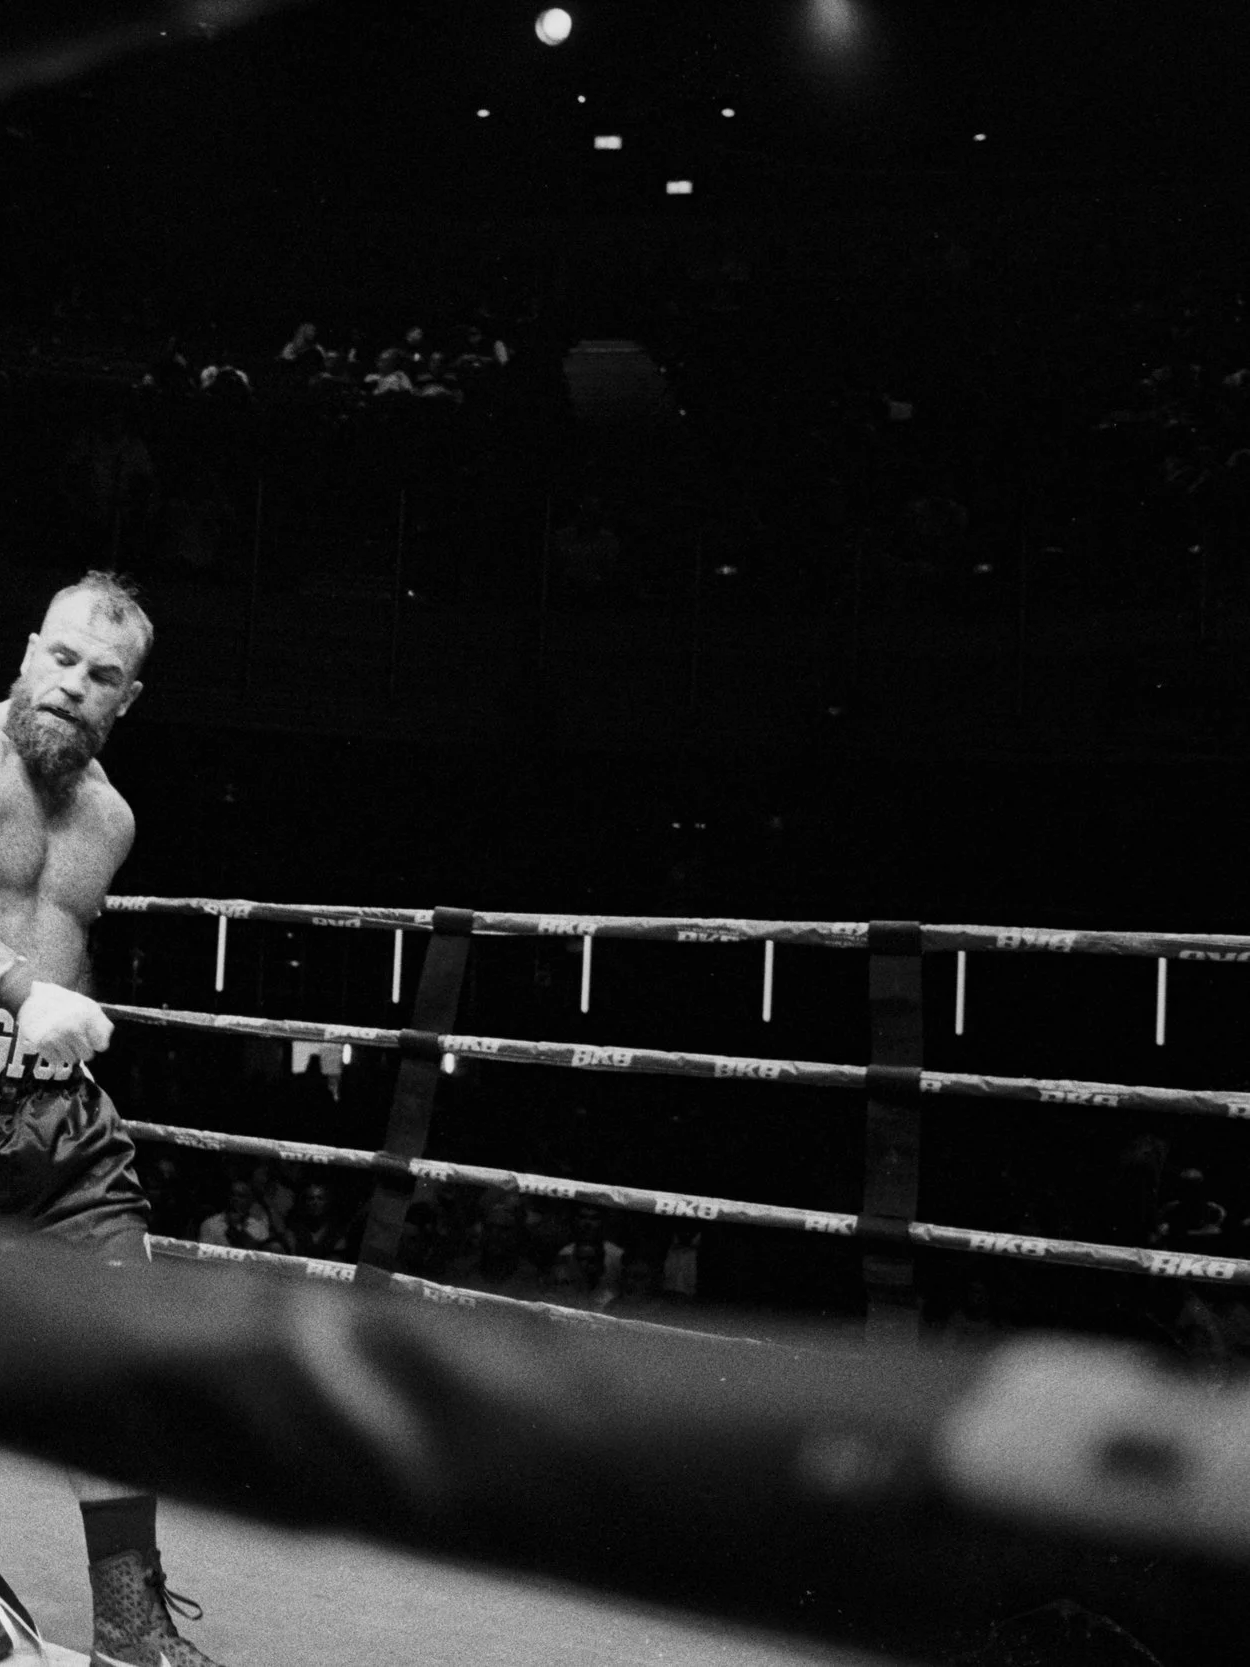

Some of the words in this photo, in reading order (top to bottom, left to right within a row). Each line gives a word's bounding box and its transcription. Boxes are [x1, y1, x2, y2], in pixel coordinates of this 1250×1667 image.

[571, 1048, 633, 1067] BKB
[714, 1060, 782, 1080] BKB
[654, 1196, 719, 1220] BKB
[969, 1234, 1048, 1257] BKB
[1150, 1251, 1236, 1279] BKB
